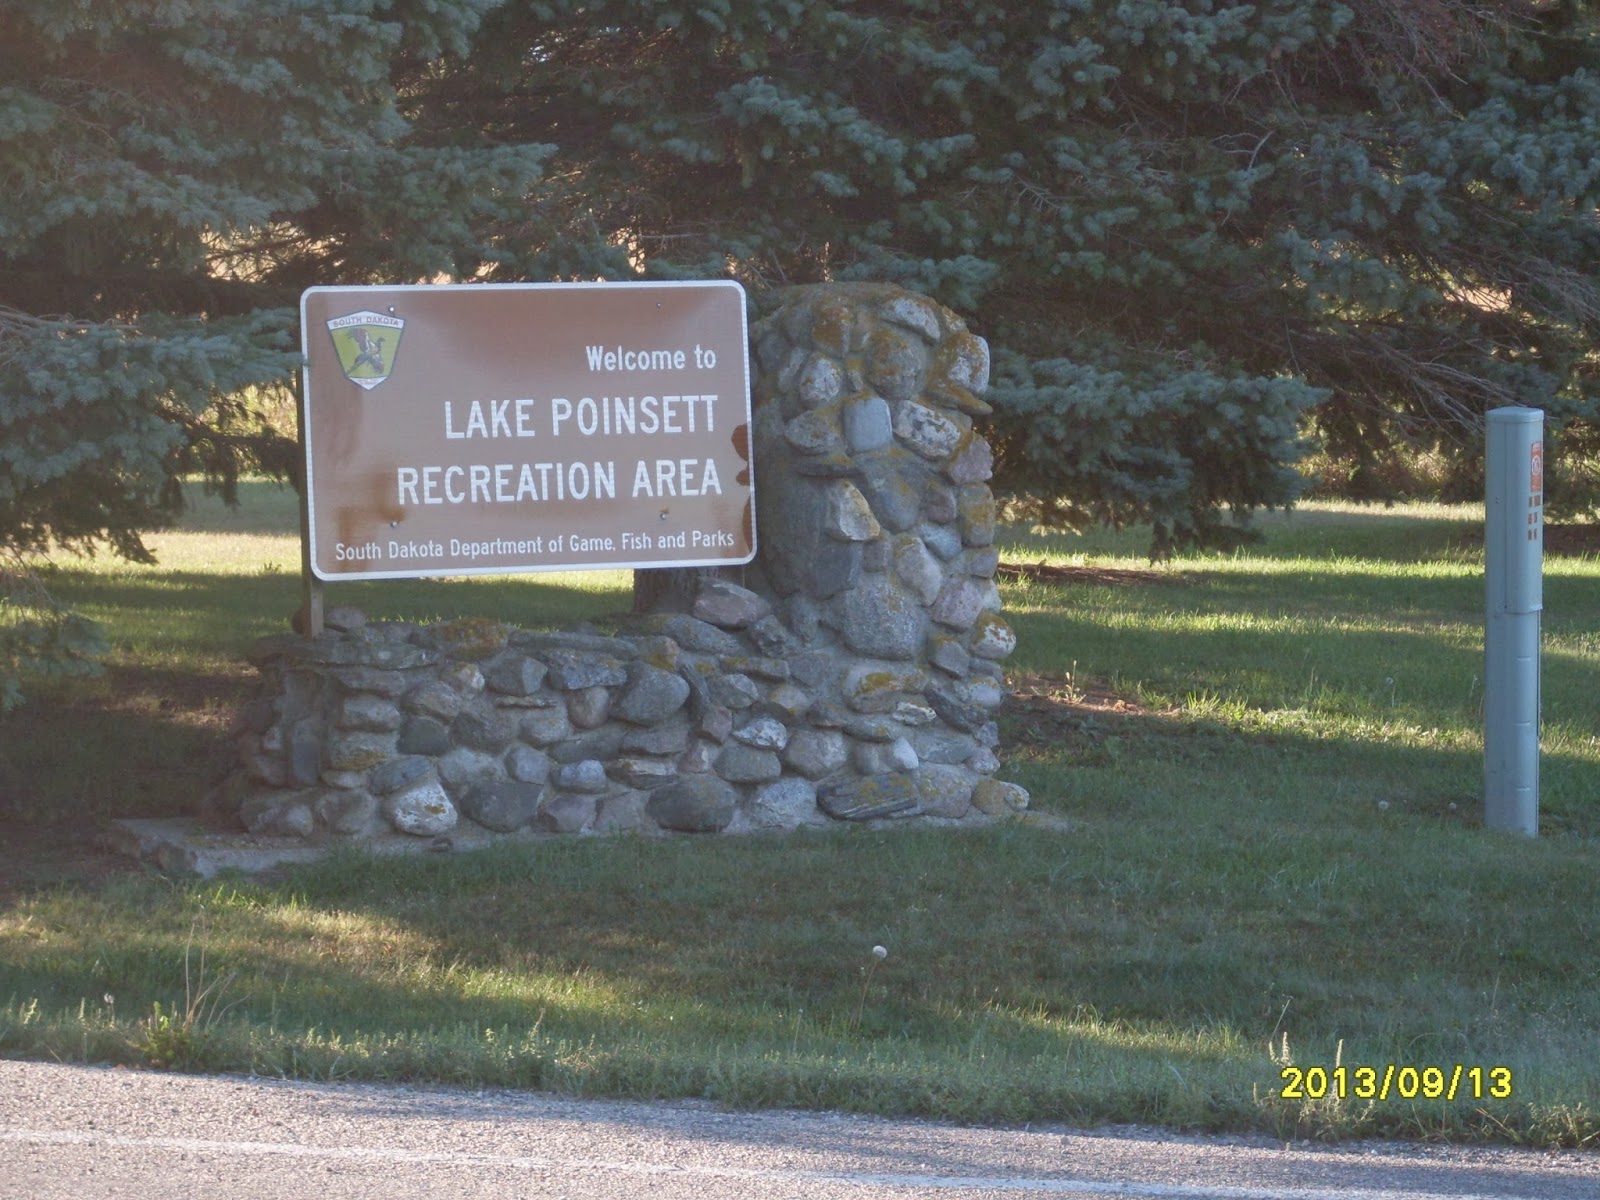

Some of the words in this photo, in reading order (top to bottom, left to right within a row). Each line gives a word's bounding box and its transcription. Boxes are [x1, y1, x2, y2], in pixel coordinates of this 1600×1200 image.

[333, 316, 362, 327] SOUTH
[366, 316, 399, 326] DAKOTA
[585, 345, 686, 371] Welcome
[694, 344, 717, 369] to
[444, 399, 536, 439] LAKE
[551, 395, 719, 436] POINSETT
[397, 462, 616, 505] RECREATION
[632, 458, 722, 497] AREA
[335, 542, 382, 561] South
[388, 539, 443, 559] Dakota
[450, 536, 542, 559] Department
[548, 535, 564, 553] of
[621, 532, 652, 550] Fish
[657, 531, 686, 549] and
[692, 530, 735, 548] Parks
